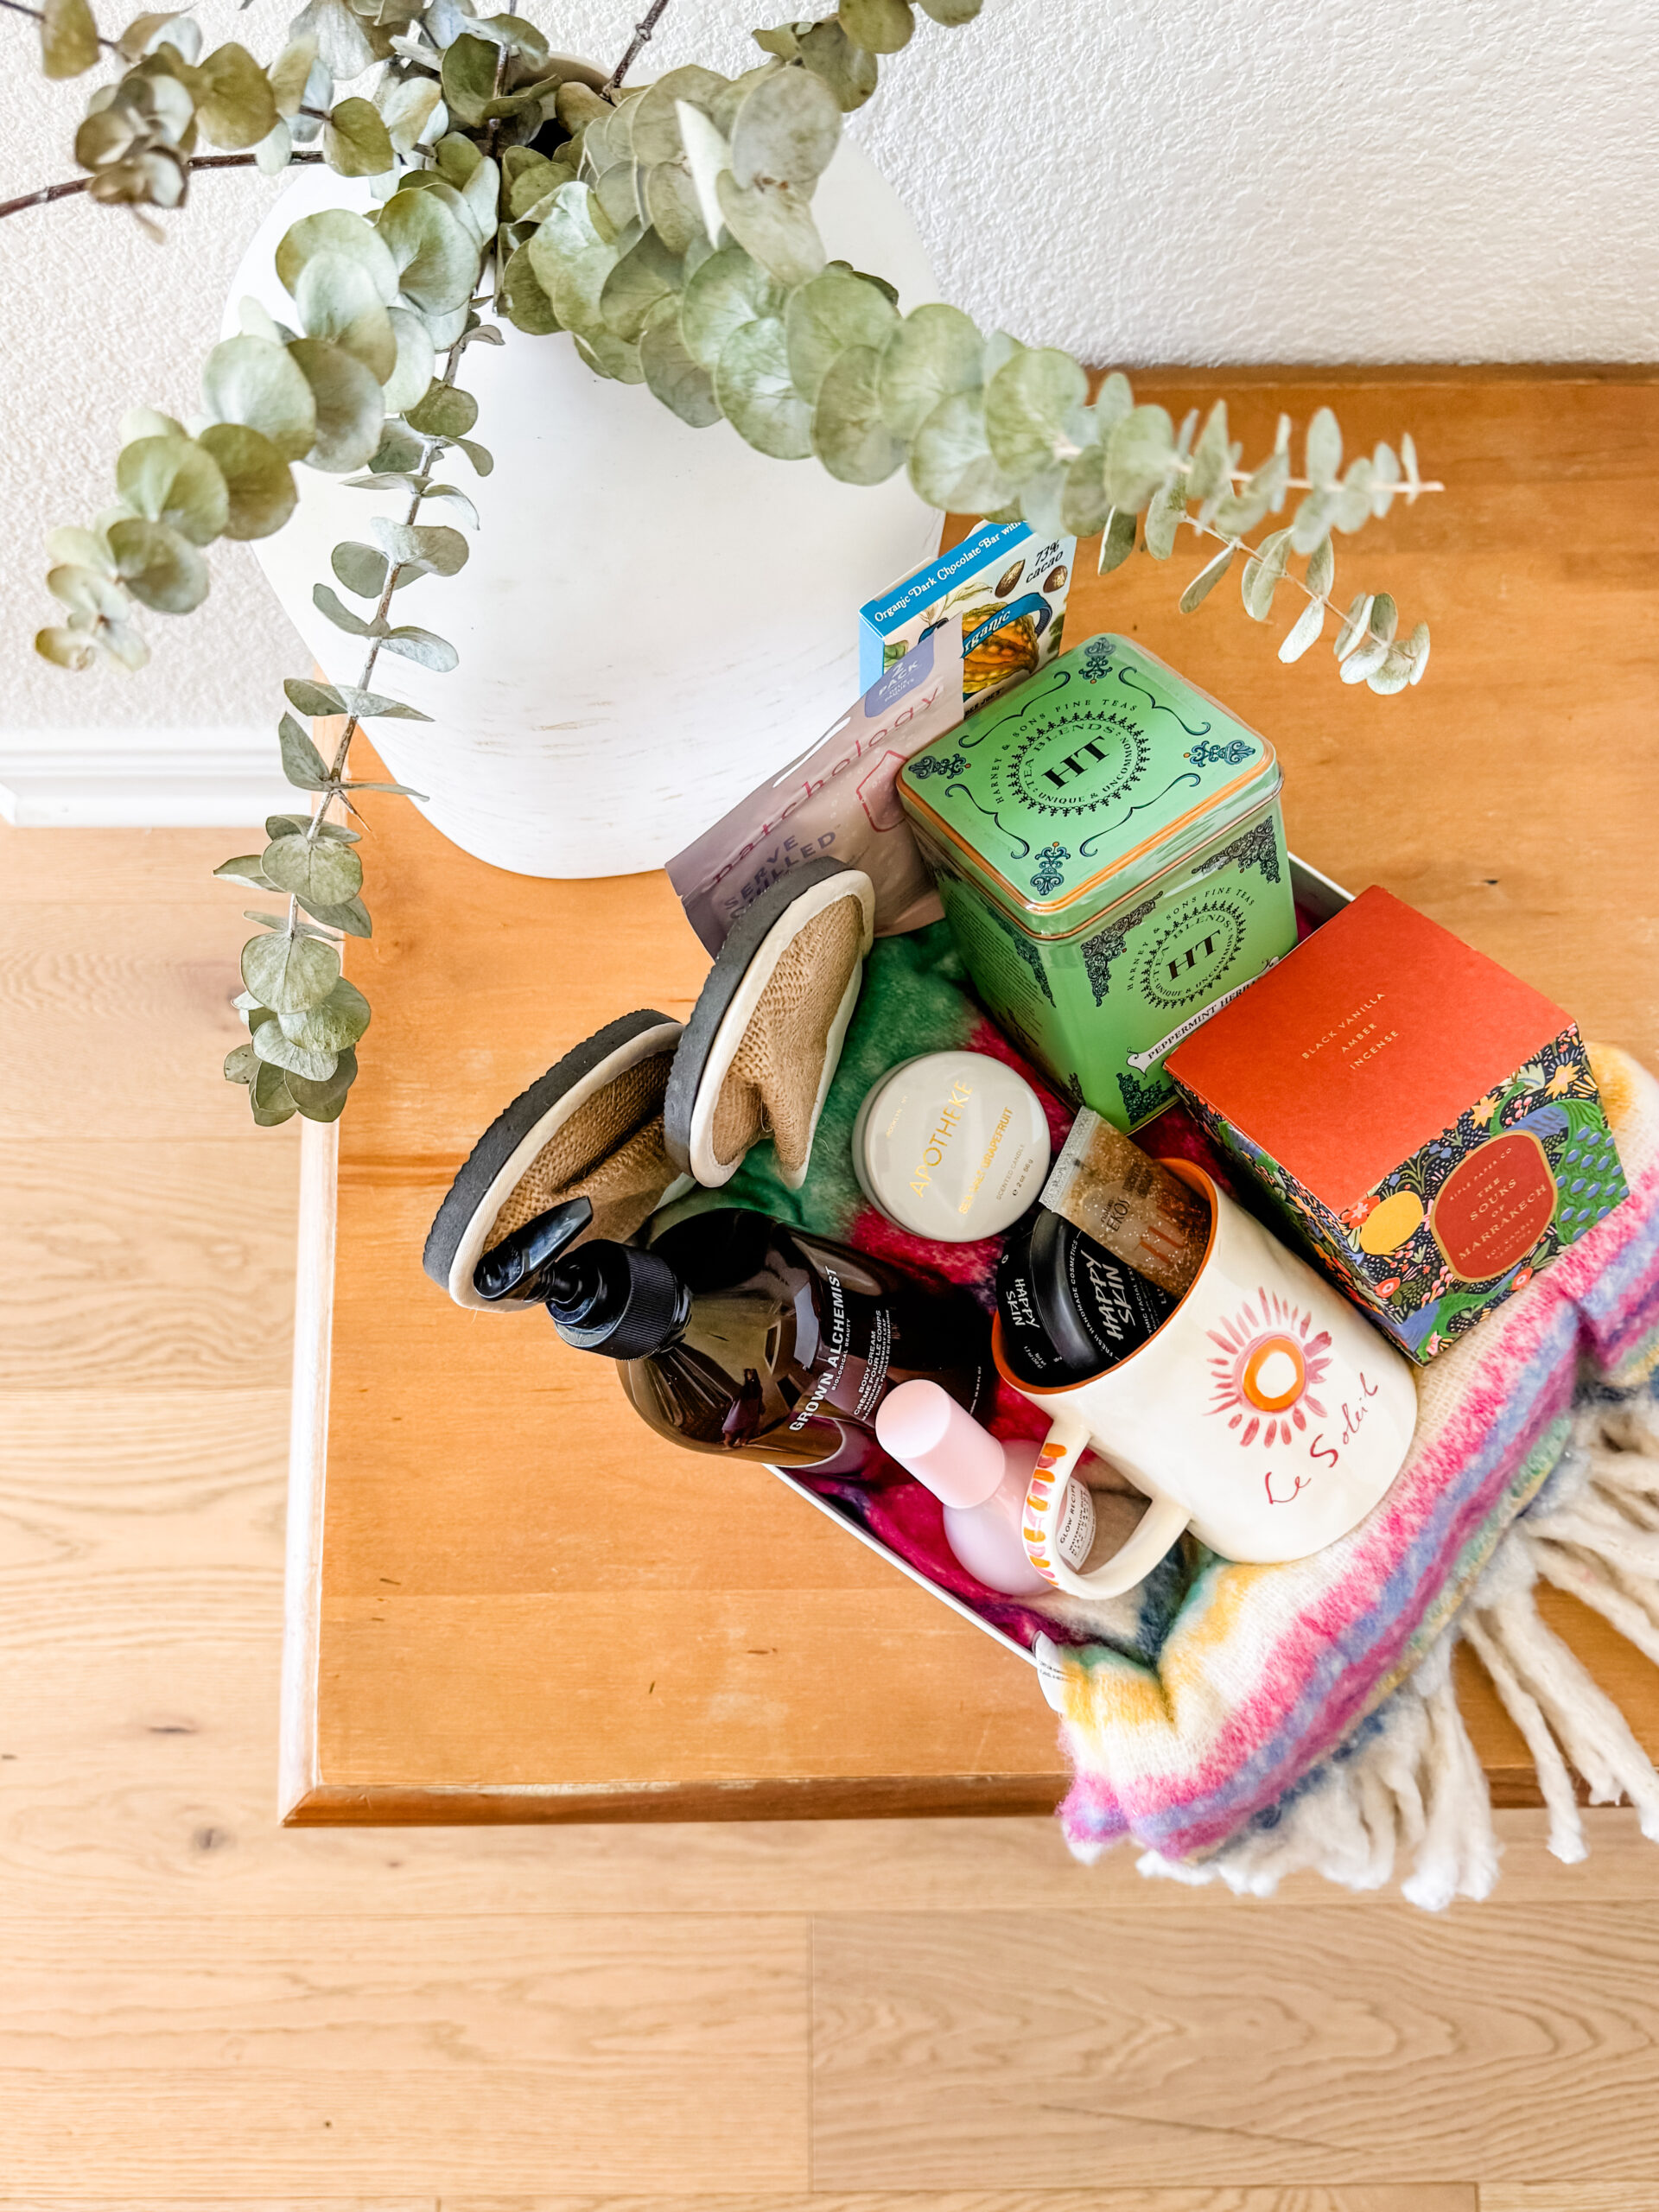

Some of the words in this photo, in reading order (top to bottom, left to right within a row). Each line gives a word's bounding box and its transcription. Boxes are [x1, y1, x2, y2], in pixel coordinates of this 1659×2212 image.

[1026, 550, 1064, 583] cacao
[1035, 539, 1060, 567] 73%
[874, 594, 911, 622] Organic
[908, 576, 938, 596] Dark
[937, 547, 982, 581] Chocolate
[979, 533, 1001, 549] Bar
[964, 609, 1012, 653] rganic
[879, 660, 918, 696] PACK
[892, 662, 904, 678] 2
[990, 758, 1005, 804] HARNEY
[1012, 713, 1046, 738] SONS
[1055, 699, 1090, 713] FINE
[1102, 699, 1138, 711] TEAS
[1023, 758, 1035, 789] TEA
[1033, 723, 1115, 752] BLENDS
[1038, 791, 1086, 804] UNIQUE
[1102, 737, 1133, 792] UNCOMMON
[1041, 735, 1110, 790] HT
[713, 687, 939, 884] patchology
[724, 835, 799, 910] SERVE
[1127, 942, 1149, 991] HARNEY
[1166, 896, 1197, 920] SONS
[1205, 887, 1232, 898] FINE
[1236, 888, 1255, 906] TEAS
[1173, 913, 1231, 939] BLENDS
[1166, 929, 1221, 982] HT
[1154, 983, 1183, 997] UNIQUE
[1147, 1004, 1217, 1060] PEPPERMINT
[1301, 1031, 1338, 1059] BLACK
[1338, 993, 1386, 1028] VANILLA
[1341, 1023, 1377, 1053] AMBER
[1349, 1030, 1399, 1070] INCENSE
[909, 1079, 974, 1198] APOTHEKE
[981, 1106, 1014, 1169] GRAPEFRUIT
[996, 1170, 1014, 1200] SCENTED
[1470, 1179, 1516, 1221] SOUKS
[1477, 1177, 1500, 1198] THE
[1106, 1197, 1130, 1232] EKOS
[1458, 1184, 1547, 1260] MARRAKECH
[1491, 1205, 1505, 1217] OF
[1069, 1239, 1079, 1285] COSMETICS
[1006, 1290, 1026, 1326] SKIN
[1014, 1278, 1040, 1328] HAPPY
[1071, 1287, 1096, 1335] HANDMADE
[1080, 1249, 1124, 1341] HAPPY
[1102, 1263, 1136, 1326] SKIN
[1133, 1285, 1146, 1313] FACIAL
[789, 1371, 834, 1432] GROWN
[825, 1265, 845, 1369] ALCHEMIST
[858, 1367, 871, 1393] BODY
[868, 1331, 876, 1365] CREAM
[869, 1357, 880, 1383] POUR
[875, 1344, 881, 1356] LE
[1094, 1333, 1114, 1357] FRESH
[831, 1349, 849, 1391] BIOLOGICAL
[1265, 1471, 1311, 1504] Le
[1309, 1372, 1378, 1468] Soleil
[1060, 1516, 1072, 1544] GLOW
